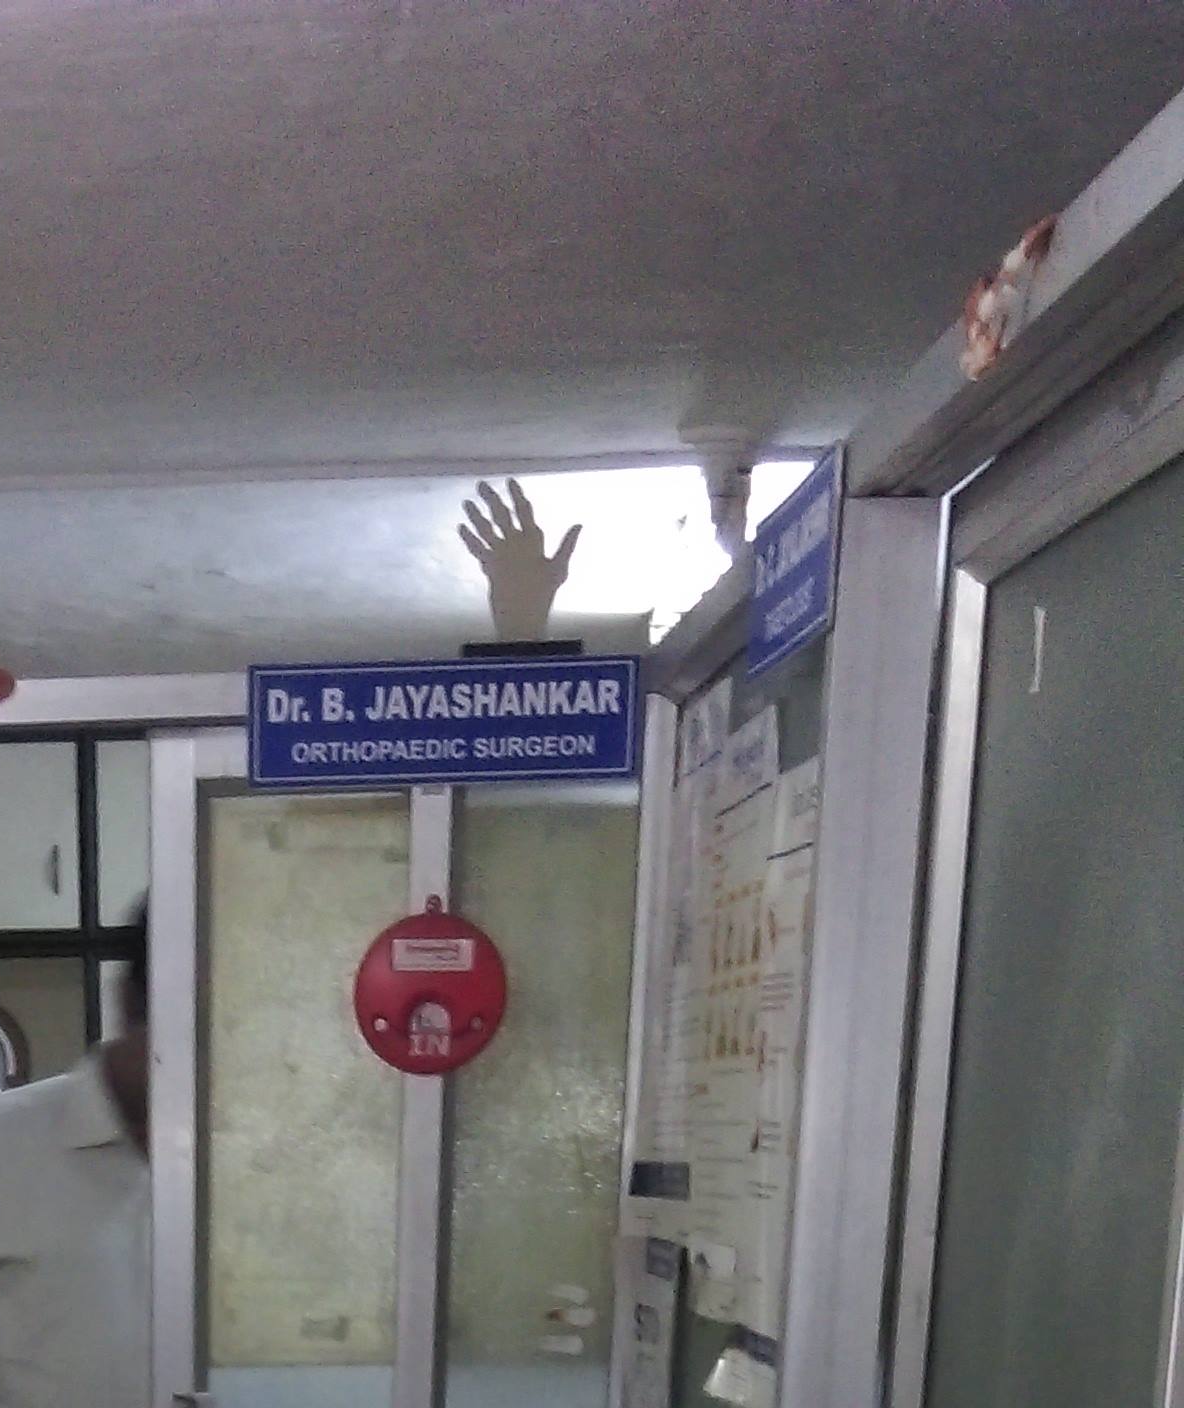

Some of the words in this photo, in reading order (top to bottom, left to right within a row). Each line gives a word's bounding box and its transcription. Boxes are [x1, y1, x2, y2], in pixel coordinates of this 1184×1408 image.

[266, 688, 310, 723] Dr.
[321, 687, 354, 722] B.
[365, 680, 621, 722] JAYASHANKAR
[291, 738, 466, 764] ORTHOPAEDIC
[472, 735, 597, 759] SURGEON
